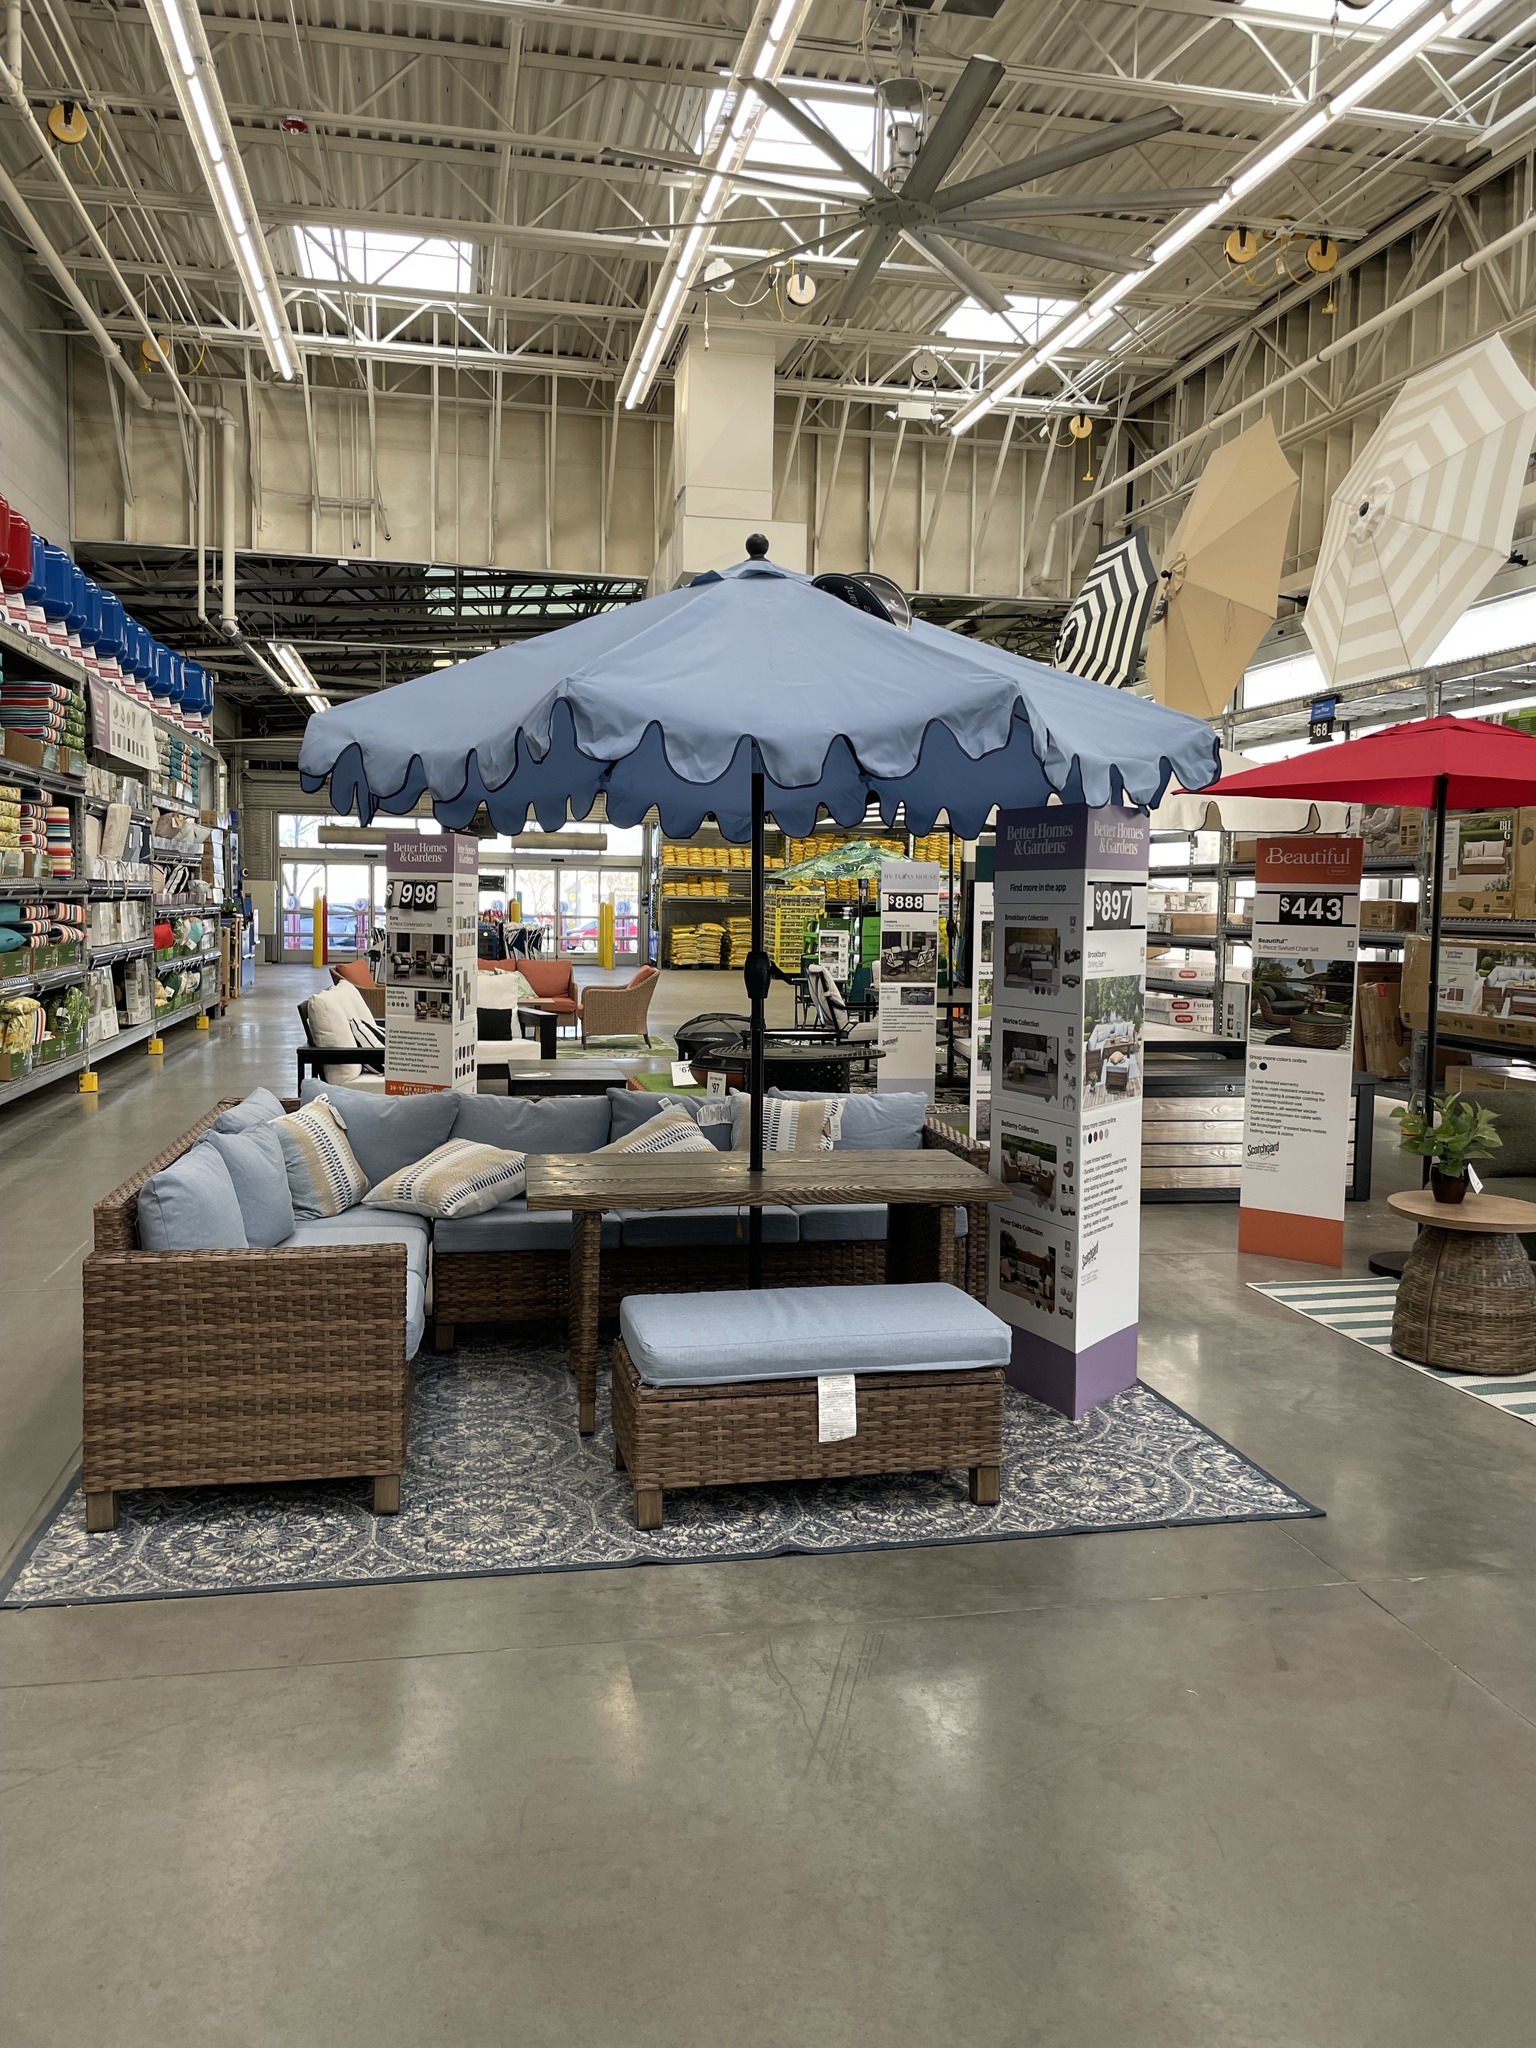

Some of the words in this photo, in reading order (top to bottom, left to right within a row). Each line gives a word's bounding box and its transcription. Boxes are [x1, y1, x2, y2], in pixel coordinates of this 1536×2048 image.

[1313, 723, 1328, 737] $68
[1007, 825, 1037, 840] Better
[1038, 823, 1073, 839] Homes
[1094, 821, 1117, 837] Better
[1117, 823, 1144, 840] Homes
[393, 842, 419, 853] Better
[419, 842, 448, 853] Homes
[1265, 848, 1351, 865] Beautiful
[1010, 883, 1022, 892] Find
[1039, 884, 1044, 892] in
[1045, 883, 1054, 892] the
[1055, 884, 1067, 893] app
[889, 895, 923, 909] $888
[1096, 889, 1132, 921] $897
[1280, 897, 1342, 921] $443
[1005, 914, 1027, 922] Brookbury
[1003, 1017, 1018, 1025] Marlow
[1018, 1019, 1040, 1027] Collection
[1018, 1124, 1039, 1134] Collection
[1246, 1141, 1280, 1157] Scotchgard
[1022, 1224, 1043, 1237] Collection
